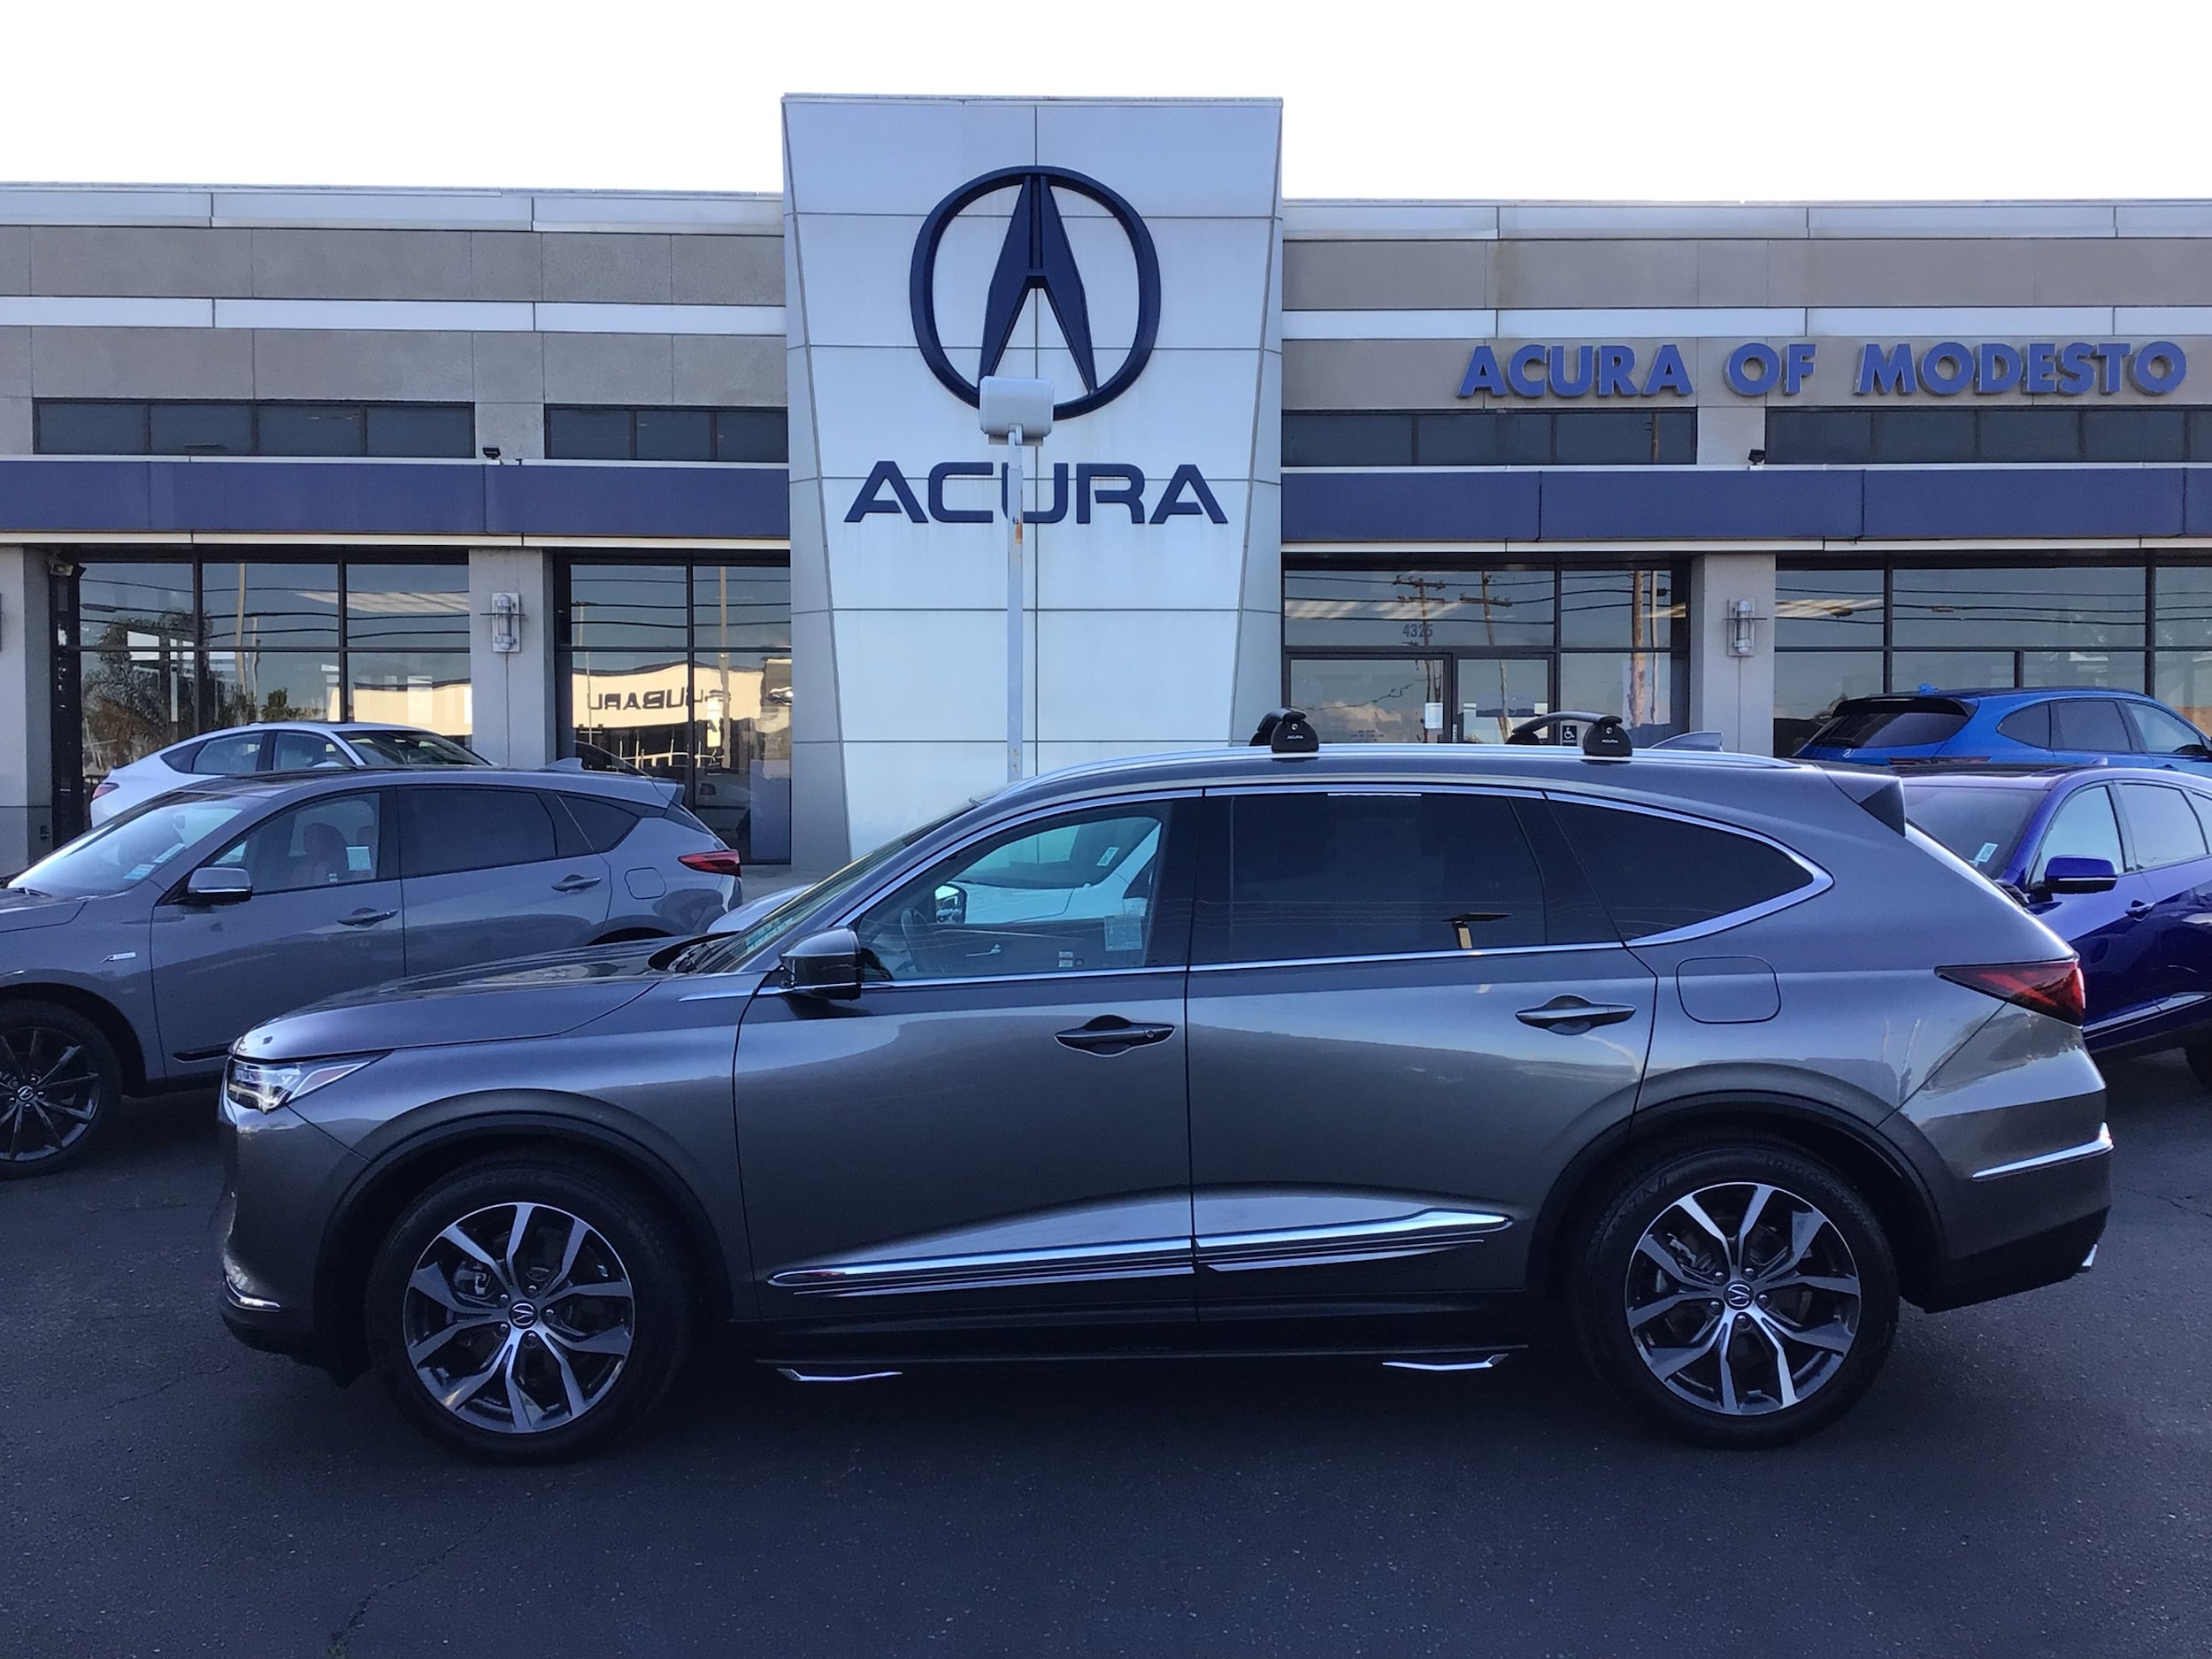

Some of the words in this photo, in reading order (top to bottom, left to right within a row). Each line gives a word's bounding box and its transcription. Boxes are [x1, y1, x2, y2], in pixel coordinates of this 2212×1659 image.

[1456, 343, 1694, 398] ACURA
[1725, 342, 1816, 396] OF
[1853, 341, 2188, 396] MODESTO
[844, 460, 1229, 524] ACURA
